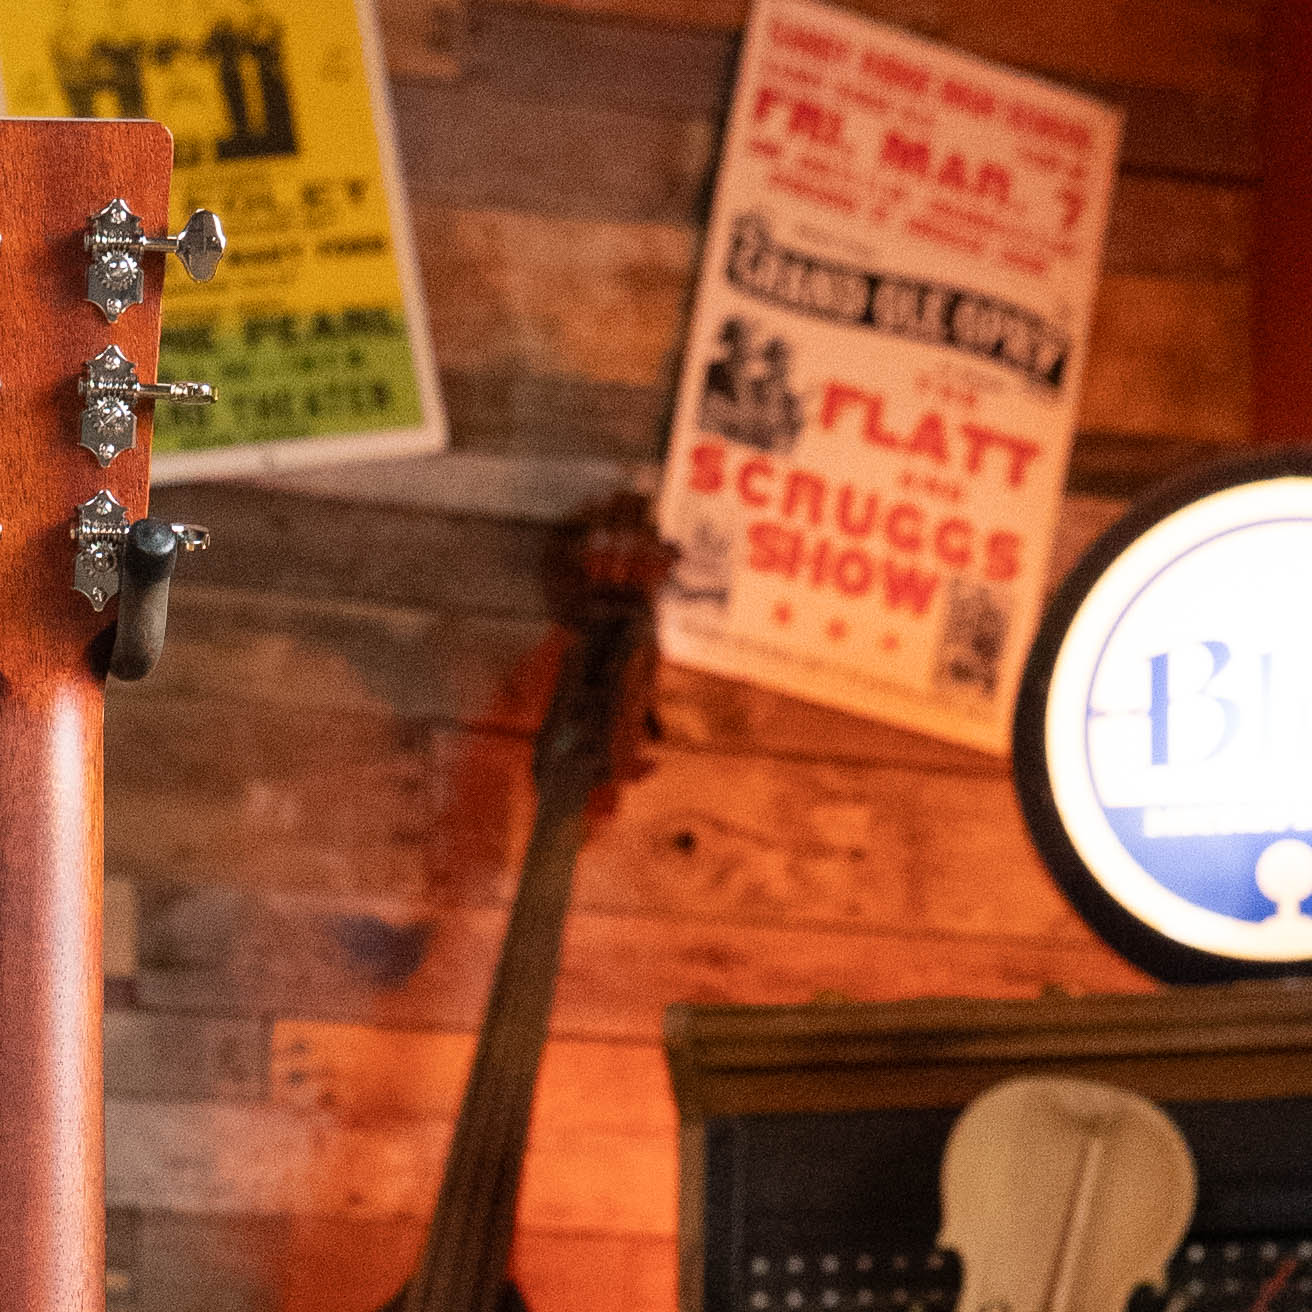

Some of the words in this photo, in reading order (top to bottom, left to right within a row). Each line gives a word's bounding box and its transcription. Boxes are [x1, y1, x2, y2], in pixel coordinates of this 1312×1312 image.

[819, 376, 1042, 491] FLATT
[690, 436, 1023, 583] SCRUGGS
[746, 520, 941, 617] SHOW
